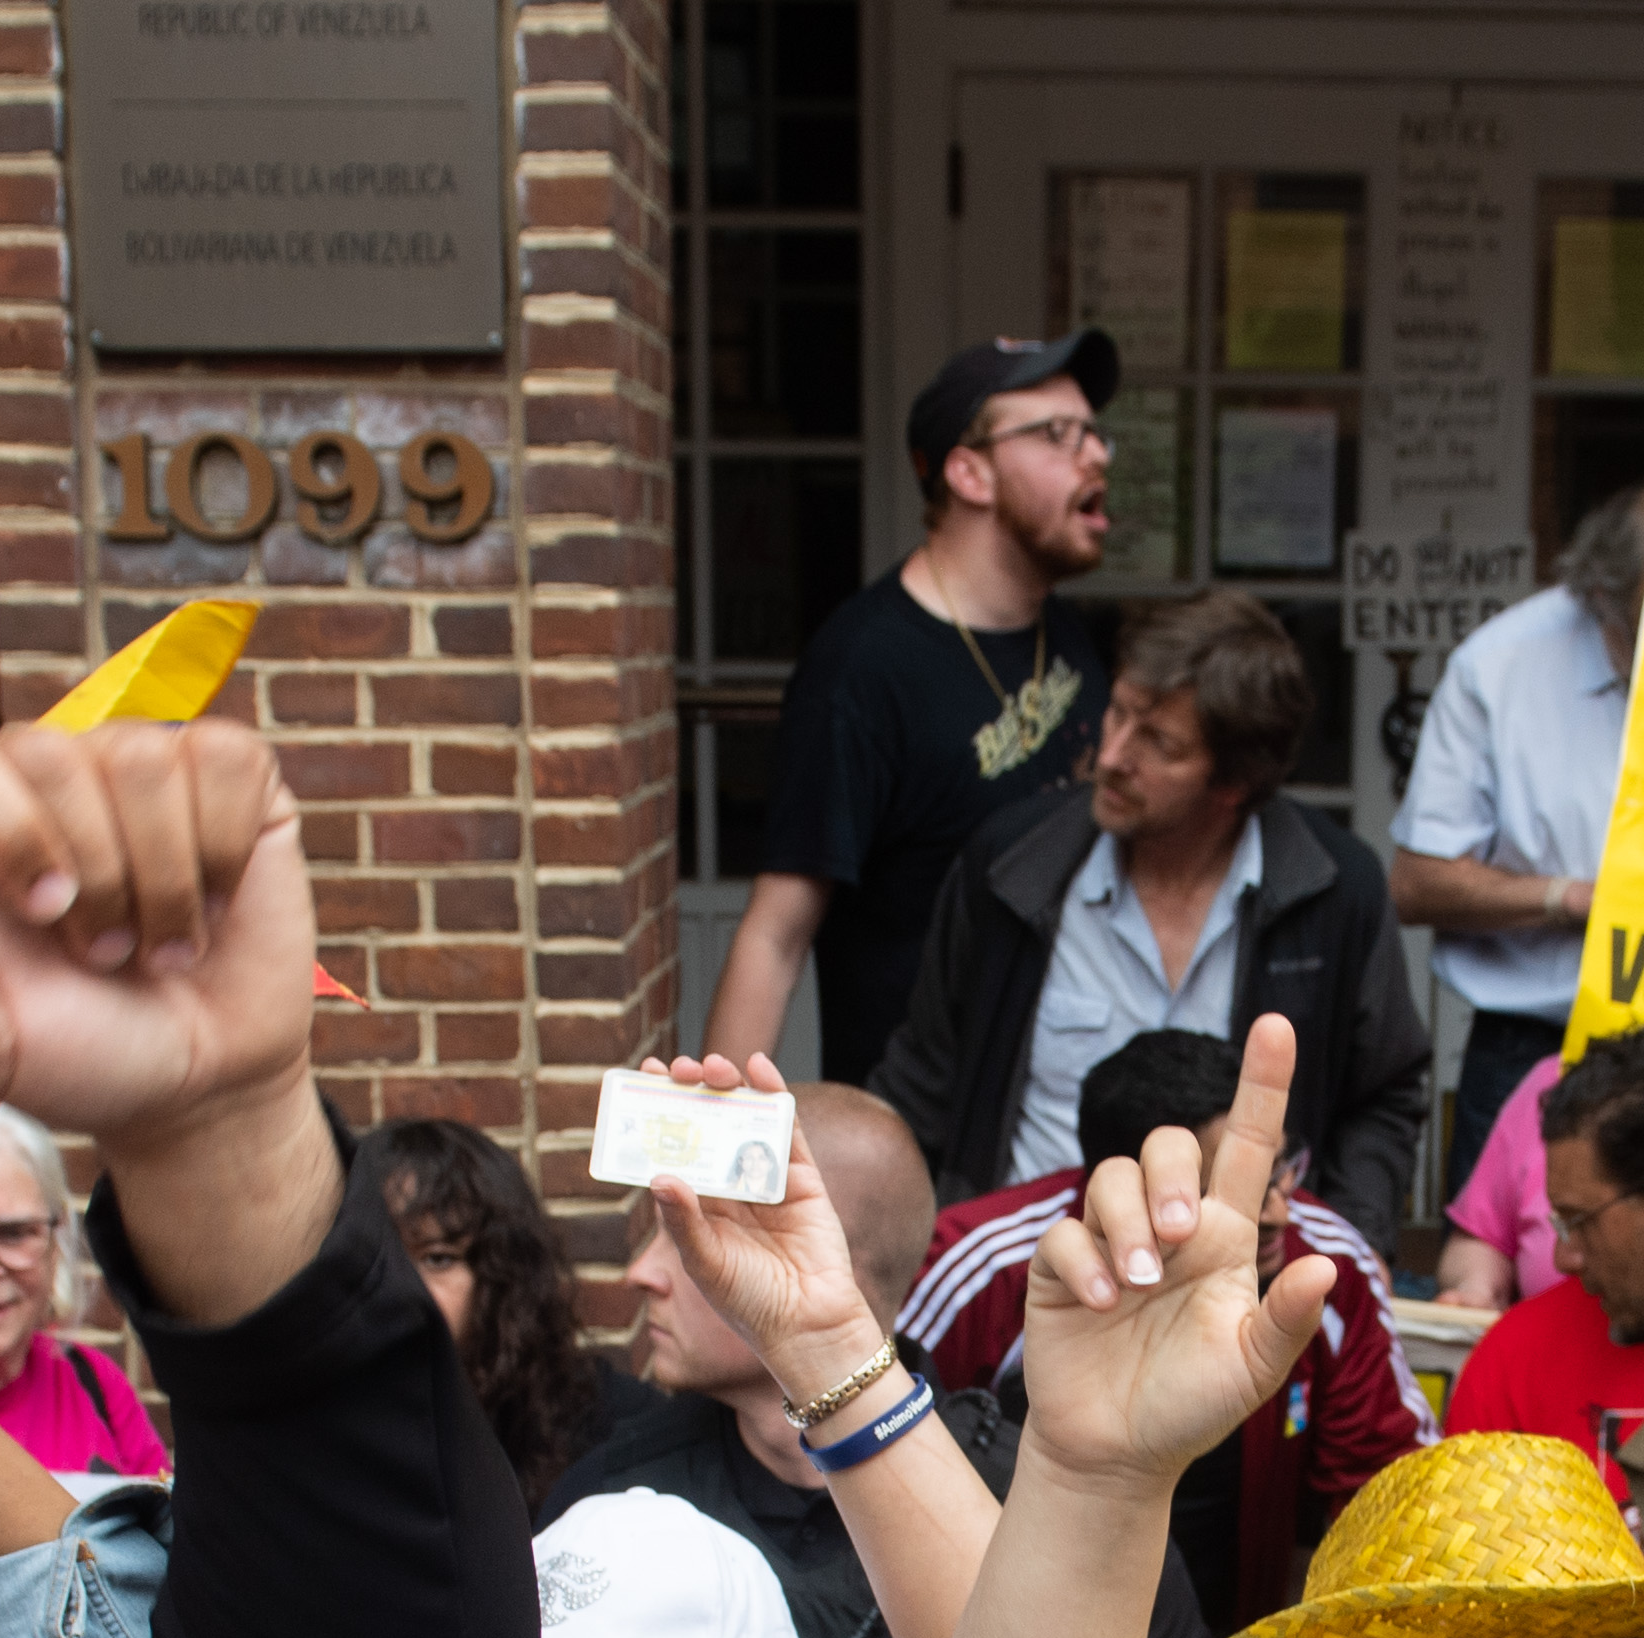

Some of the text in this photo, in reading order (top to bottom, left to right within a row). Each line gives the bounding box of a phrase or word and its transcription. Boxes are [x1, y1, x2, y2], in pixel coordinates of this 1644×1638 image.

[138, 4, 432, 36] REPUBLIC OF VENEZUELA
[323, 230, 458, 268] VENEZUELA
[101, 430, 496, 545] 1099
[1356, 543, 1399, 587] DO
[1458, 545, 1527, 588] NOT
